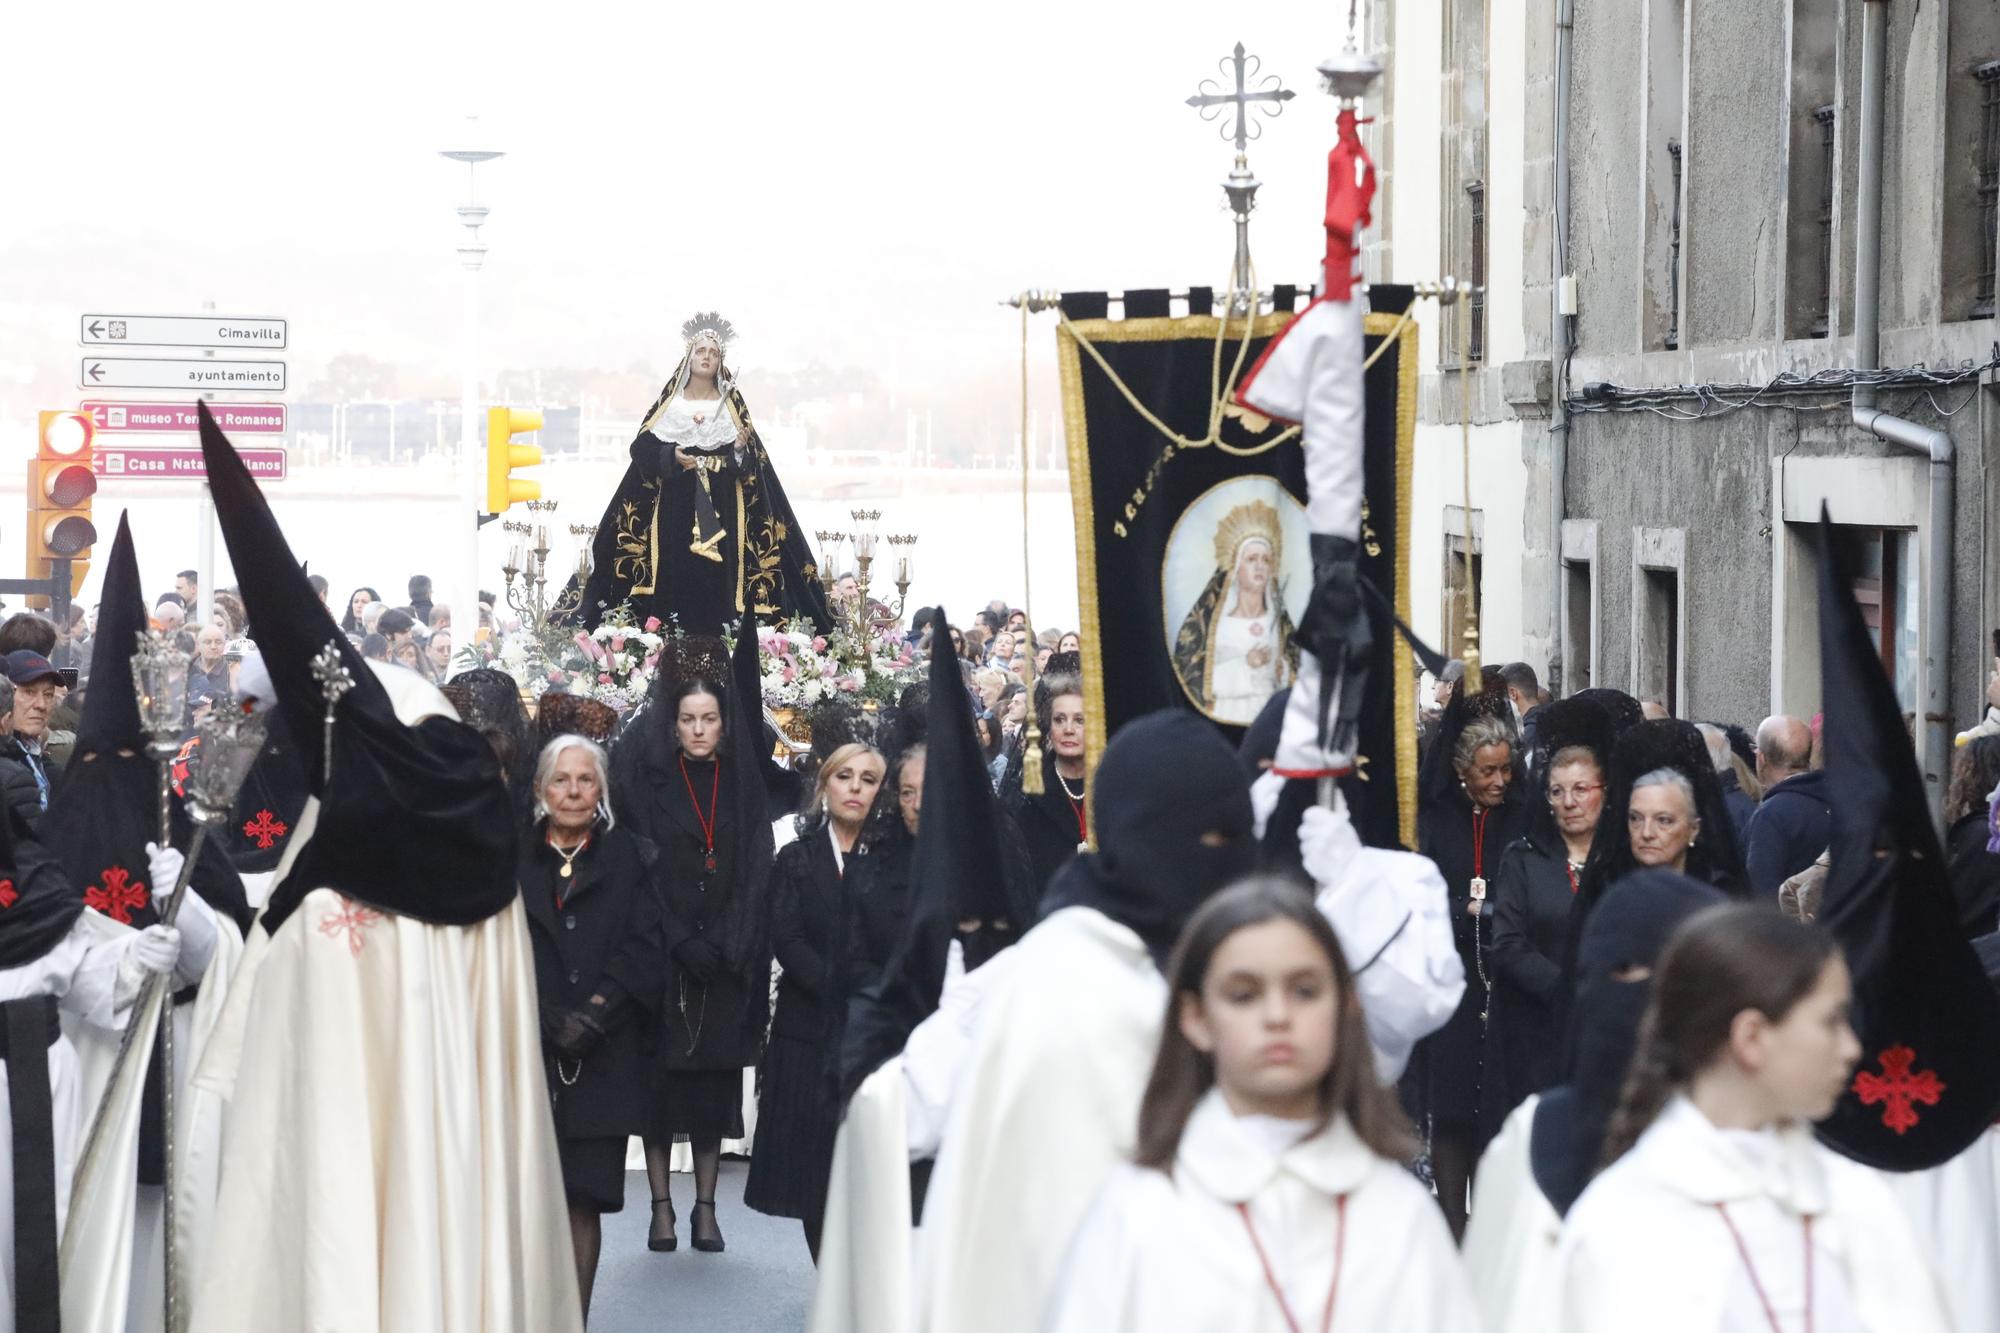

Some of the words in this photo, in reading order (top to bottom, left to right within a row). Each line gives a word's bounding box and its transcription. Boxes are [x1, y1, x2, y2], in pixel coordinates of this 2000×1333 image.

[218, 327, 281, 339] Cimavilla
[188, 370, 280, 382] ayuntamiento
[131, 414, 172, 424] museo
[175, 413, 222, 425] Ters
[225, 413, 281, 426] Romanes
[128, 458, 166, 470] Casa
